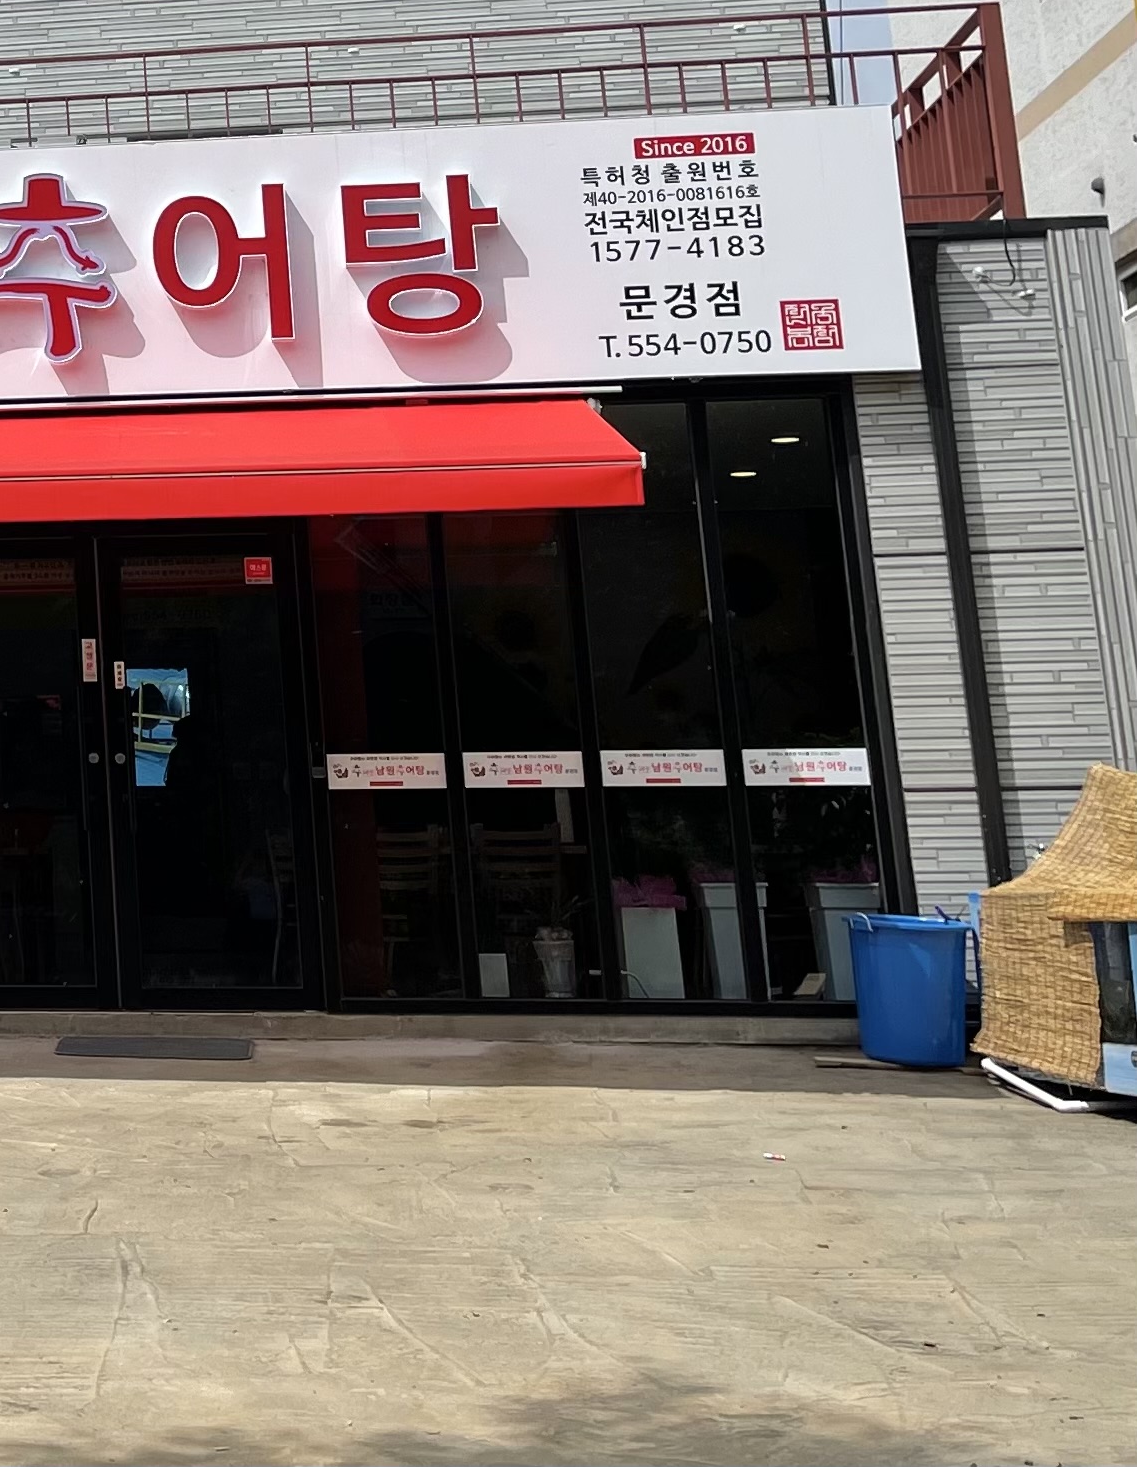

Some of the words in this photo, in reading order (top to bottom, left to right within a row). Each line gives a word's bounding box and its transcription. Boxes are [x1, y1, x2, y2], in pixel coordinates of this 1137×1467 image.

[640, 136, 695, 157] Since
[699, 135, 748, 154] 2016
[580, 164, 651, 187] 특허청
[661, 160, 759, 184] 출원번호
[582, 184, 761, 207] 제40-2016-0081616호
[584, 203, 763, 236] 전국체인점모집
[589, 234, 766, 262] 1577-4183
[619, 280, 742, 320] 문경점
